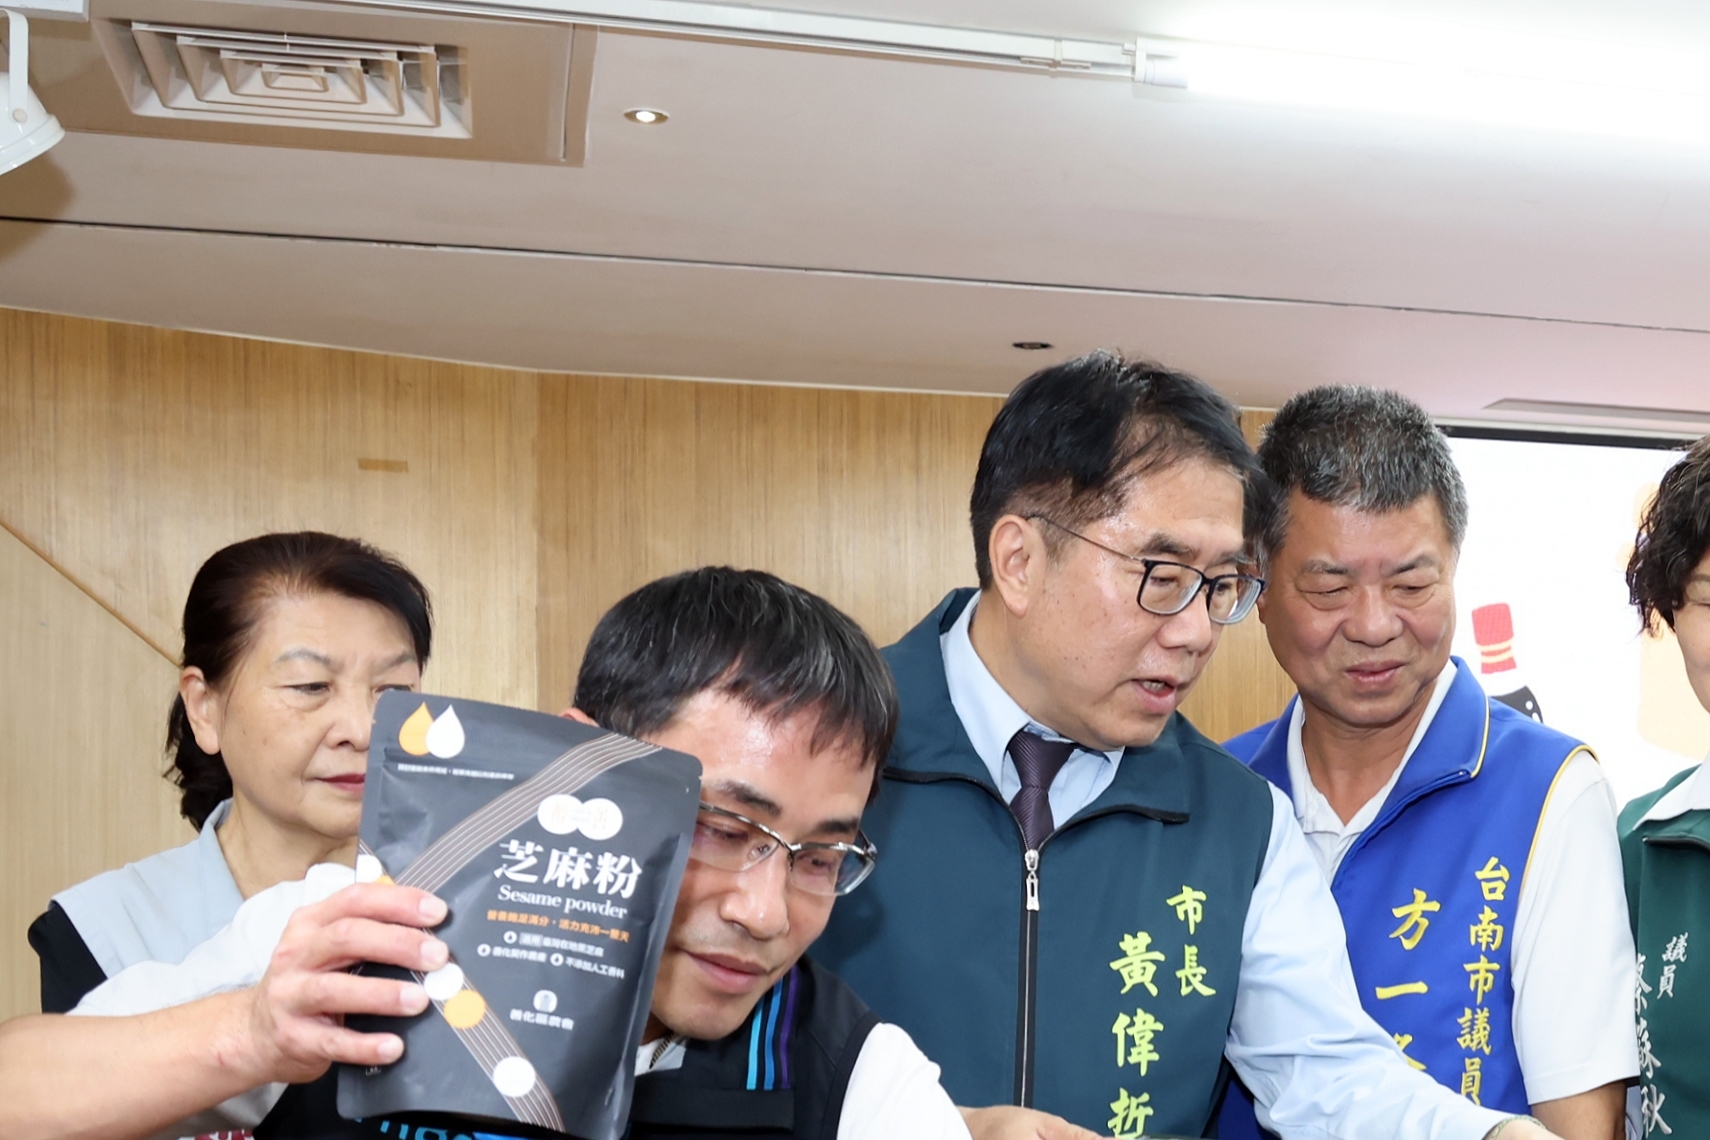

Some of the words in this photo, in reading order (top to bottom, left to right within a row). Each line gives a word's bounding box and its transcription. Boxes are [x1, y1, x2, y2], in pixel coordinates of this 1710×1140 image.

[493, 839, 642, 899] 芝麻粉
[497, 884, 562, 907] Sesame
[563, 900, 628, 919] powder
[1166, 884, 1217, 997] 市長
[1456, 856, 1510, 1107] 台南市議員
[1657, 932, 1689, 999] 議員
[1107, 931, 1166, 1140] 黃偉哲
